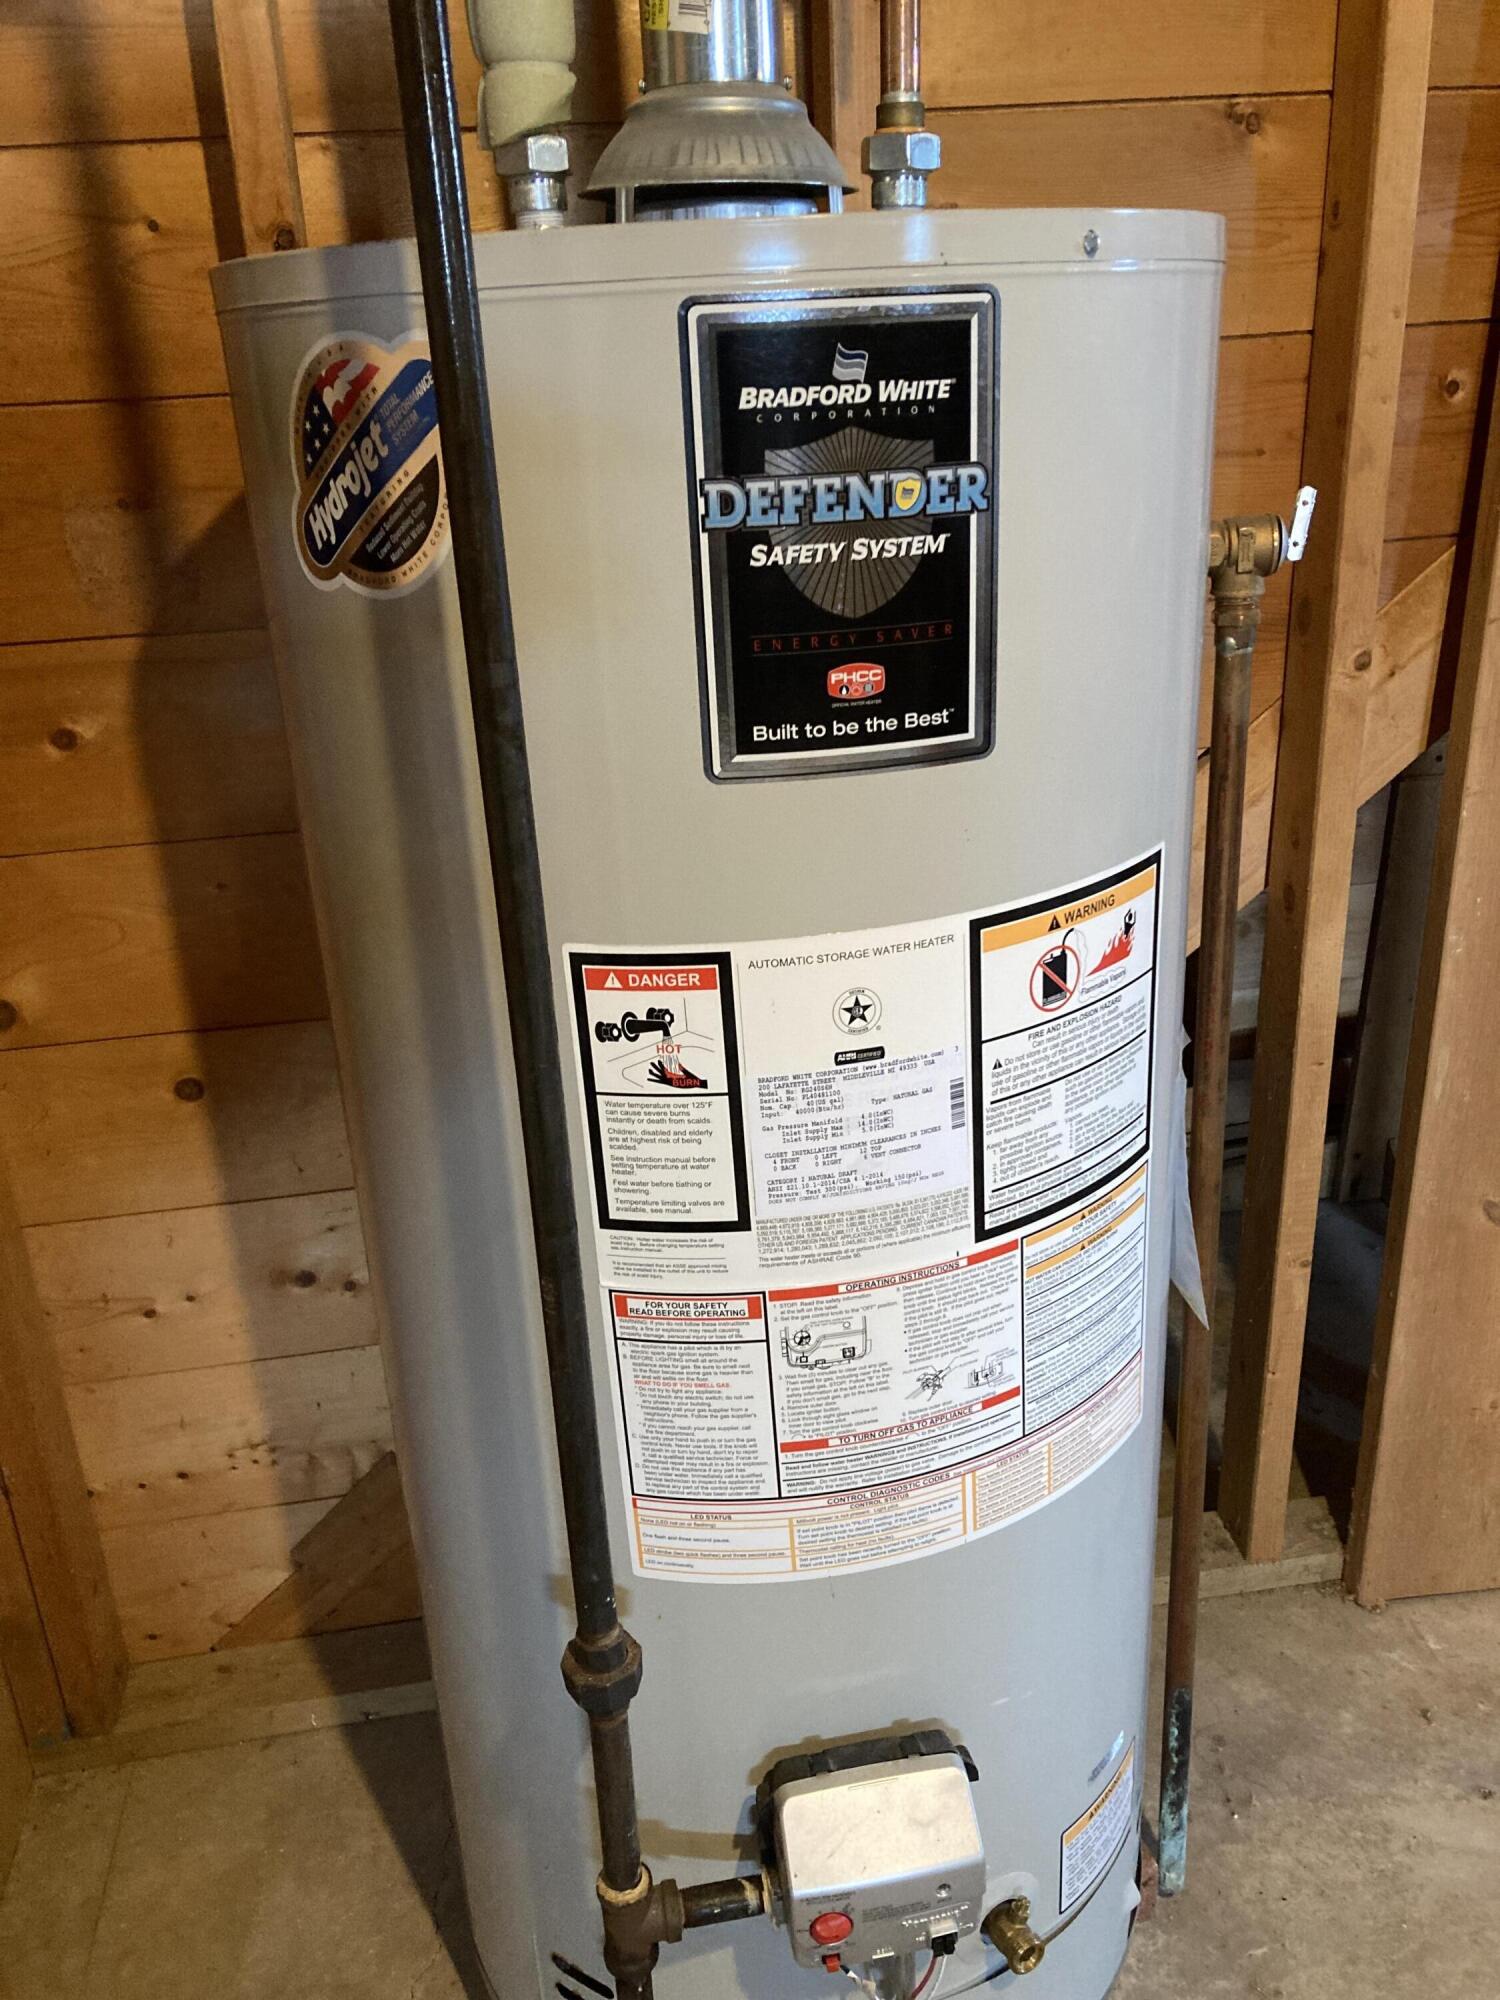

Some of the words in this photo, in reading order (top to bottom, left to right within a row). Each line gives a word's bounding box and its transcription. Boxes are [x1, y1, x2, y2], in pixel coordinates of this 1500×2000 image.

[739, 384, 872, 409] BRADFORD
[878, 379, 952, 403] WHITE
[756, 405, 935, 423] CORPORATION
[309, 418, 389, 550] Hydrojet
[702, 466, 989, 529] DEFENDER
[749, 541, 847, 567] SAFETY
[851, 533, 947, 561] SYSTEM
[753, 633, 857, 651] ENERGY
[876, 623, 953, 642] SAVER
[831, 669, 883, 684] PHCC
[753, 723, 799, 742] Built
[805, 723, 826, 738] to
[833, 720, 859, 736] be
[865, 716, 898, 733] the
[904, 709, 949, 728] Best
[1064, 894, 1116, 925] WARNING
[748, 955, 814, 969] AUTOMATIC
[816, 948, 870, 964] STORAGE
[872, 942, 911, 957] WATER
[914, 934, 954, 950] HEATER
[628, 973, 700, 987] DANGER
[1027, 1029, 1045, 1041] FIRE
[1046, 1023, 1061, 1035] AND
[1062, 1008, 1098, 1028] EXPLOSION
[1100, 994, 1122, 1011] HAZARD
[656, 1044, 682, 1054] HOT
[672, 1078, 700, 1087] BURN
[758, 1076, 789, 1084] BRADFORD
[815, 1066, 858, 1078] CORPORATION
[773, 1080, 809, 1090] LAFAYETTE
[812, 1077, 836, 1085] STREET
[843, 1069, 885, 1081] MIDDLEVILLE
[899, 1062, 918, 1071] 49333
[760, 1096, 782, 1104] Serial
[893, 1090, 919, 1100] NATURAL
[921, 1086, 933, 1094] GAS
[604, 1100, 626, 1108] Water
[627, 1102, 671, 1110] temperature
[691, 1101, 713, 1109] 125°F
[778, 1122, 808, 1130] Pressure
[811, 1118, 843, 1127] Manifold
[782, 1129, 801, 1138] Inlet
[804, 1126, 828, 1135] Supply
[630, 1137, 656, 1145] highest
[681, 1137, 702, 1145] being
[688, 1129, 713, 1137] elderly
[783, 1136, 802, 1144] Inlet
[806, 1133, 829, 1141] Supply
[791, 1145, 837, 1157] INSTALLATION
[840, 1141, 868, 1150] MINIMUM
[869, 1133, 907, 1145] CLEARANCES
[920, 1125, 942, 1135] INCHES
[626, 1155, 662, 1163] instruction
[780, 1156, 800, 1165] FRONT
[822, 1158, 842, 1167] RIGHT
[870, 1151, 886, 1159] VENT
[888, 1143, 922, 1156] CONNECTOR
[611, 1162, 635, 1170] setting
[635, 1163, 679, 1171] temperature
[612, 1178, 629, 1186] Feel
[675, 1181, 703, 1189] bathing
[767, 1177, 797, 1186] CATEGORY
[808, 1173, 835, 1181] NATURAL
[838, 1169, 858, 1177] DRAFT
[615, 1197, 660, 1206] Temperature
[661, 1199, 687, 1208] limiting
[845, 1276, 897, 1292] OPERATING
[899, 1260, 961, 1282] INSTRUCTIONS
[629, 1308, 653, 1316] READ
[655, 1309, 692, 1317] BEFORE
[693, 1309, 746, 1317] OPERATING
[645, 1301, 663, 1309] FOR
[838, 1436, 850, 1444] TO
[853, 1432, 876, 1442] TURN
[878, 1427, 895, 1438] OFF
[897, 1422, 915, 1434] GAS
[917, 1419, 928, 1428] TO
[929, 1406, 973, 1427] APPLIANCE
[827, 1493, 868, 1505] CONTROL
[870, 1480, 921, 1498] DIAGNOSTIC
[923, 1472, 950, 1486] CODES
[850, 1498, 883, 1510] CONTROL
[884, 1493, 910, 1503] STATUS
